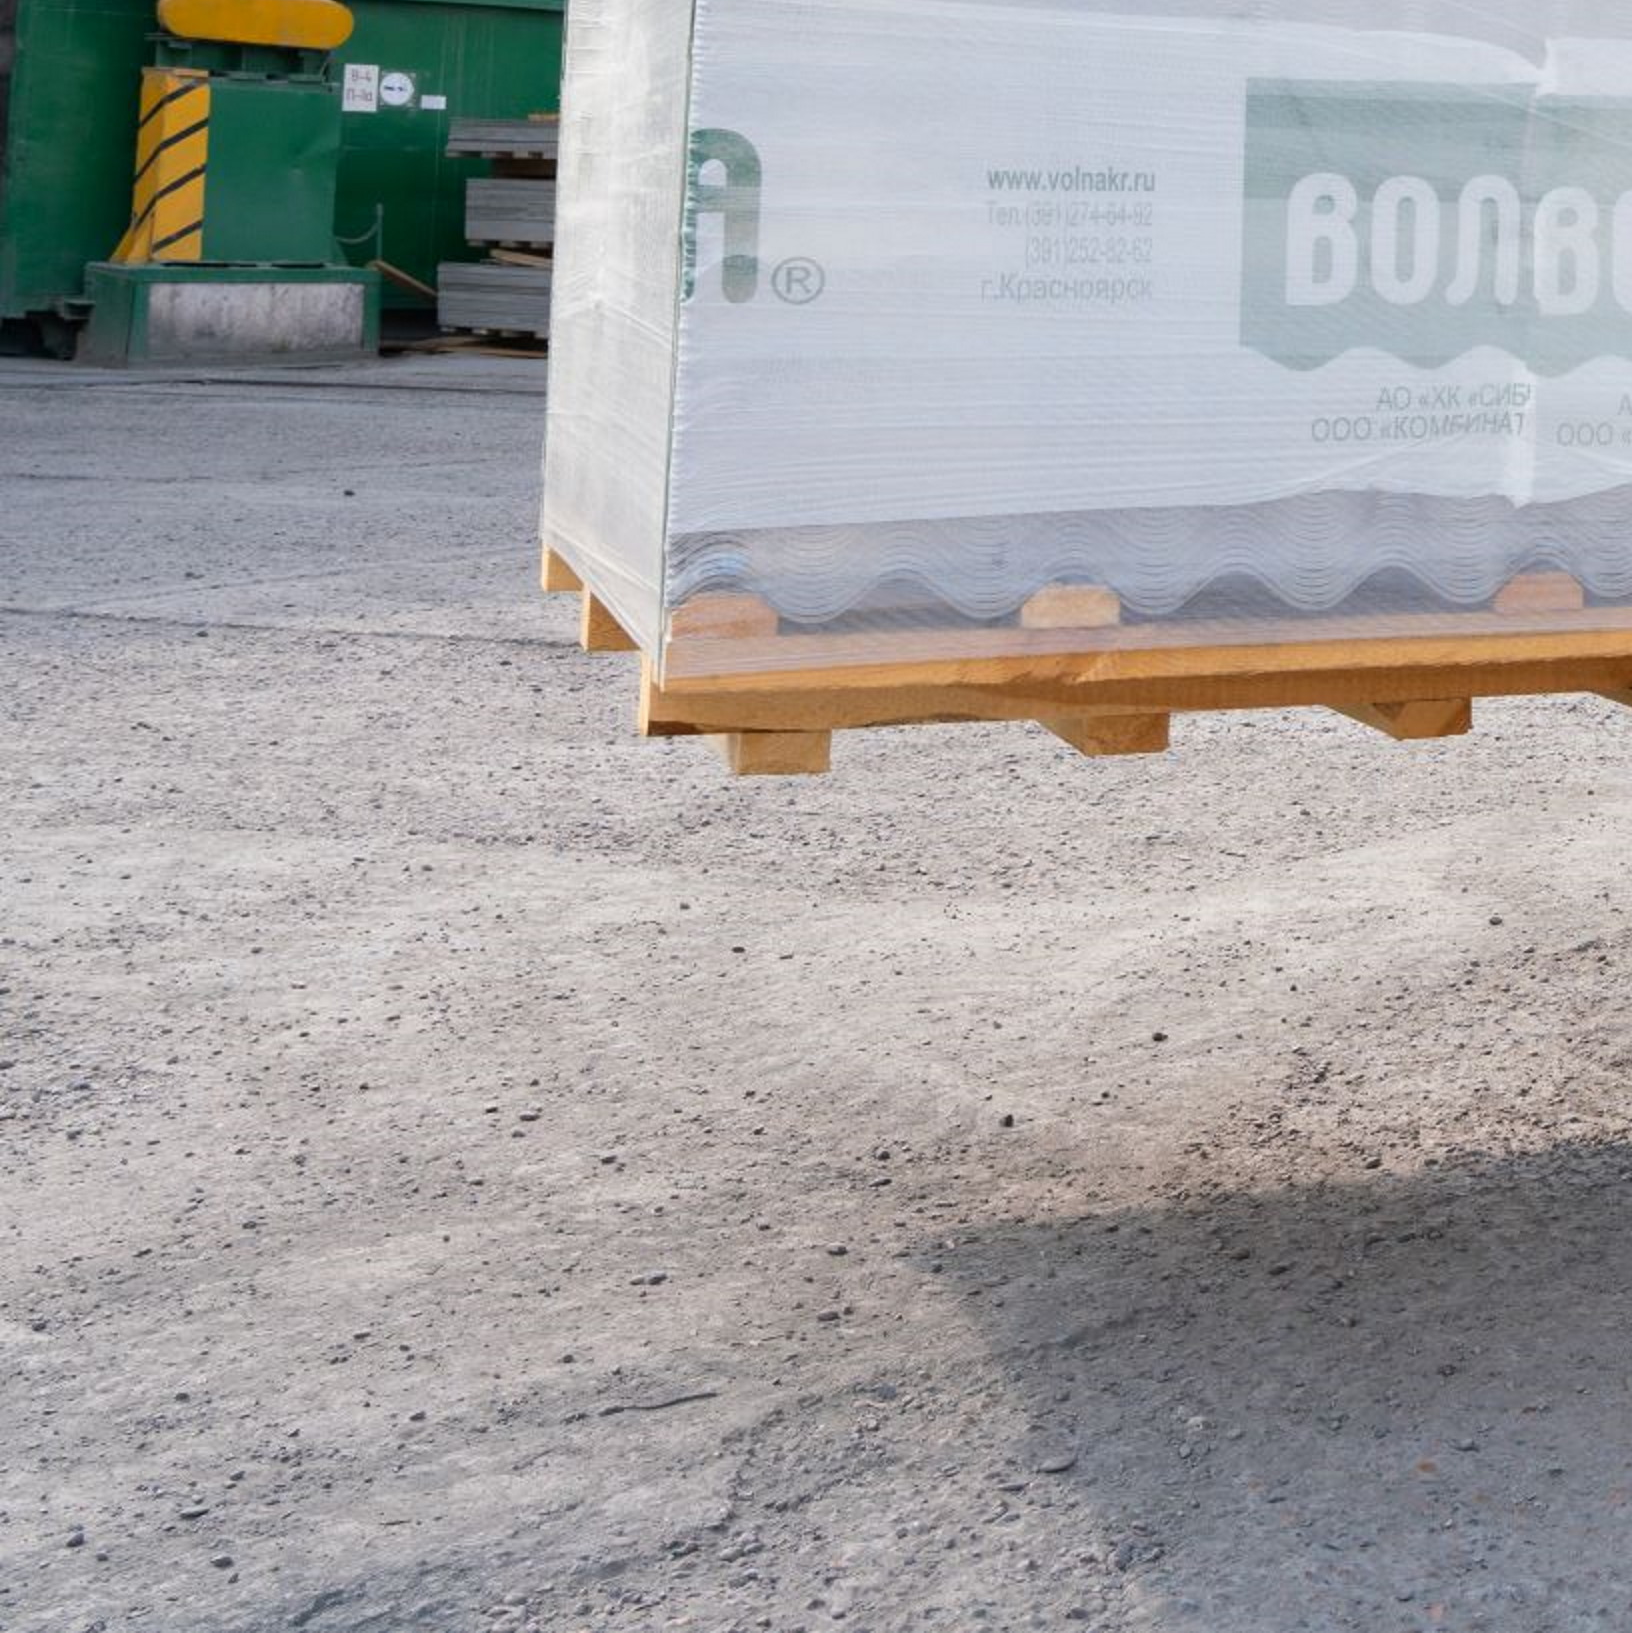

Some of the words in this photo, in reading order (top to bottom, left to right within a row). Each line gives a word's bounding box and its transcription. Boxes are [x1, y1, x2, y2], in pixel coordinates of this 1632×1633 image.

[987, 165, 1156, 192] www.volnakr.ru
[1376, 385, 1411, 412] АО
[1311, 415, 1372, 443] ООО
[1556, 421, 1613, 447] ООО
